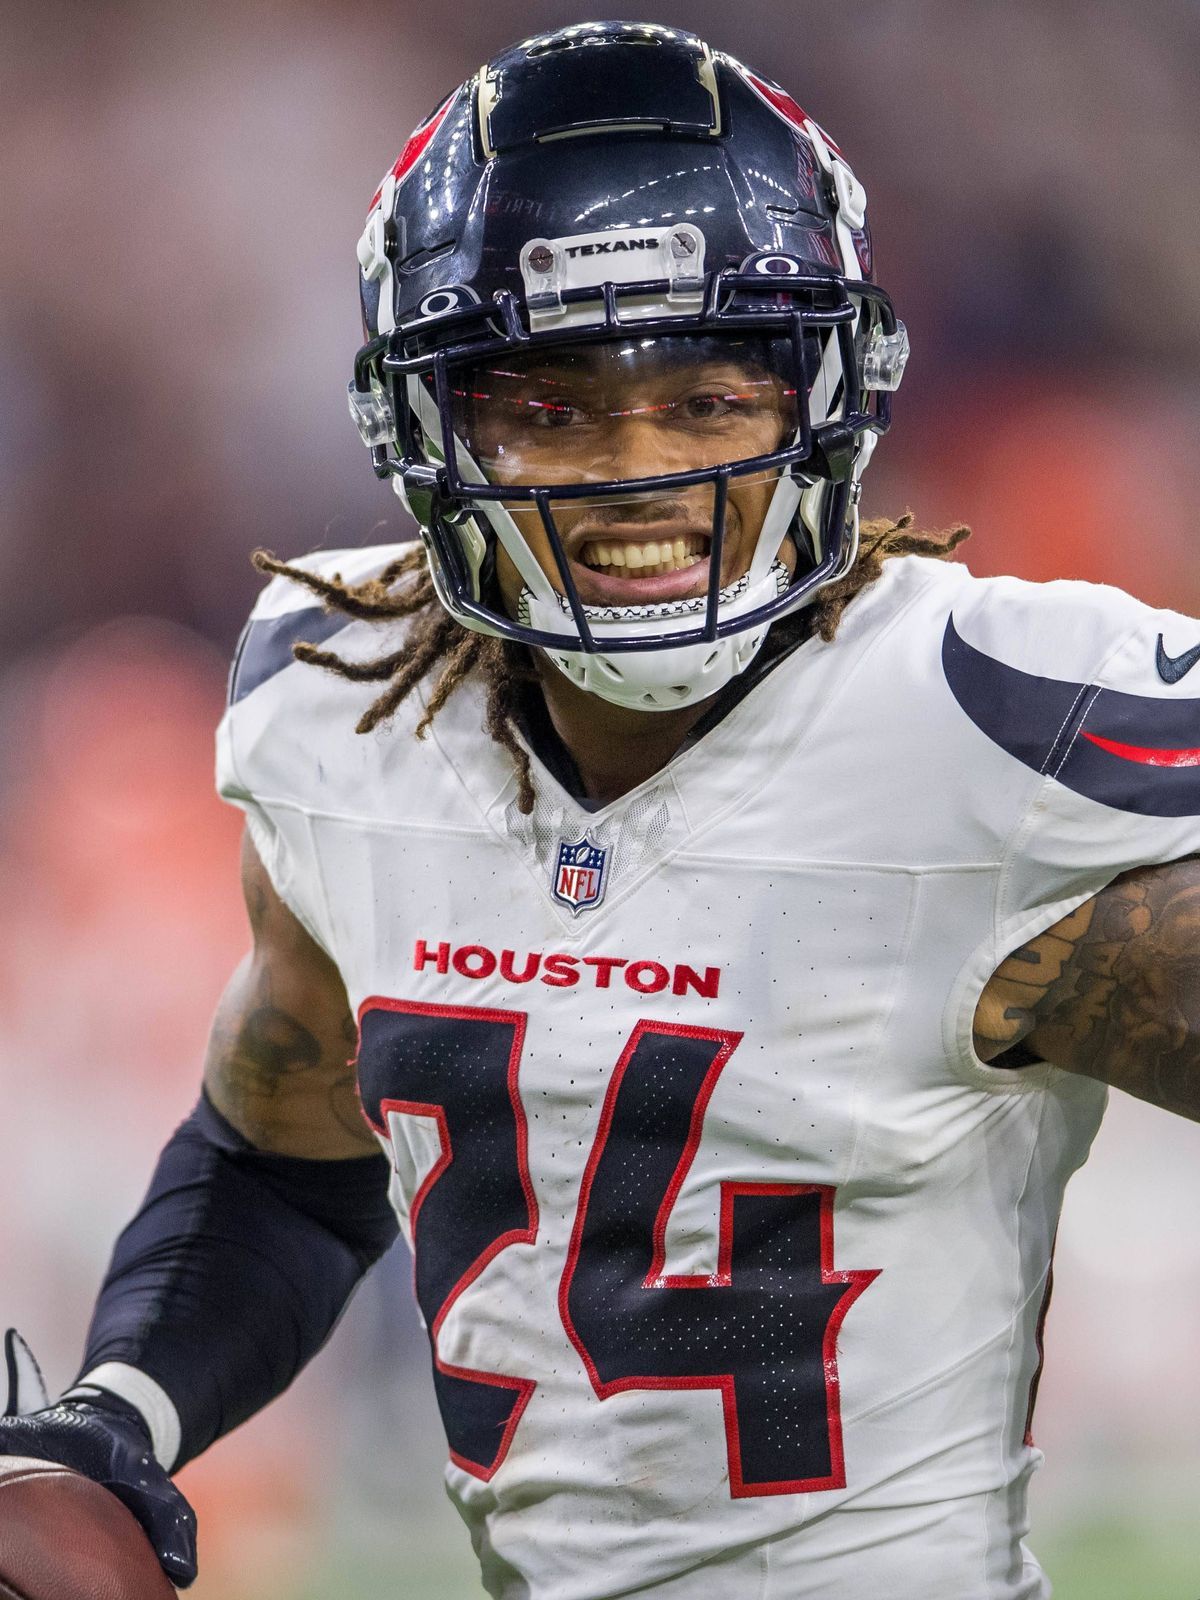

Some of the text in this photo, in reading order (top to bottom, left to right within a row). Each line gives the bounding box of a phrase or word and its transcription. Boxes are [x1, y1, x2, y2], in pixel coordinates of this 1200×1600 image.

[565, 238, 659, 259] TEXANS
[558, 867, 597, 902] NFL
[413, 939, 721, 998] HOUSTON
[355, 996, 883, 1499] 24
